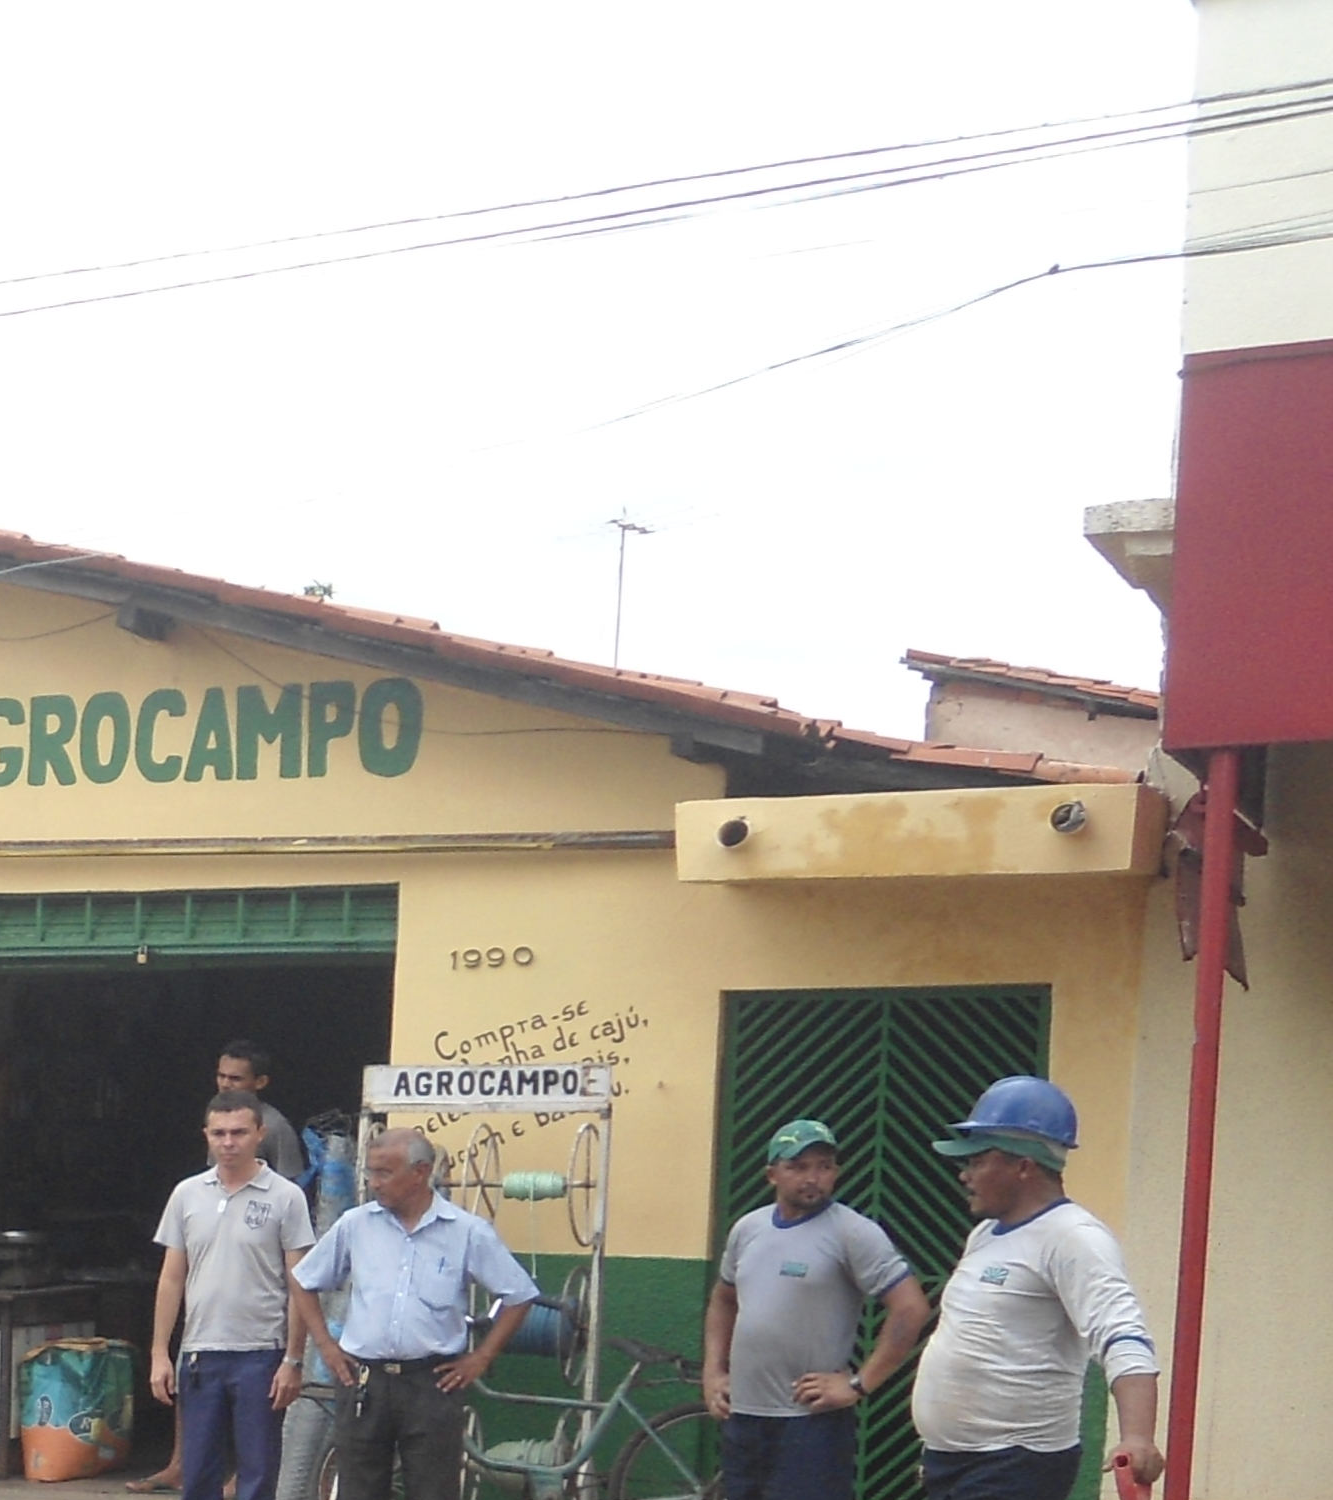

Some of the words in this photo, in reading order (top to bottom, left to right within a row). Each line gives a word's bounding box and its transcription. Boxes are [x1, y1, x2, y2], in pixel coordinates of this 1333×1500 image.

[450, 946, 534, 970] 1990
[434, 1000, 590, 1060] Compra-se
[552, 1026, 580, 1052] de
[393, 1068, 579, 1097] AGROCAMPO
